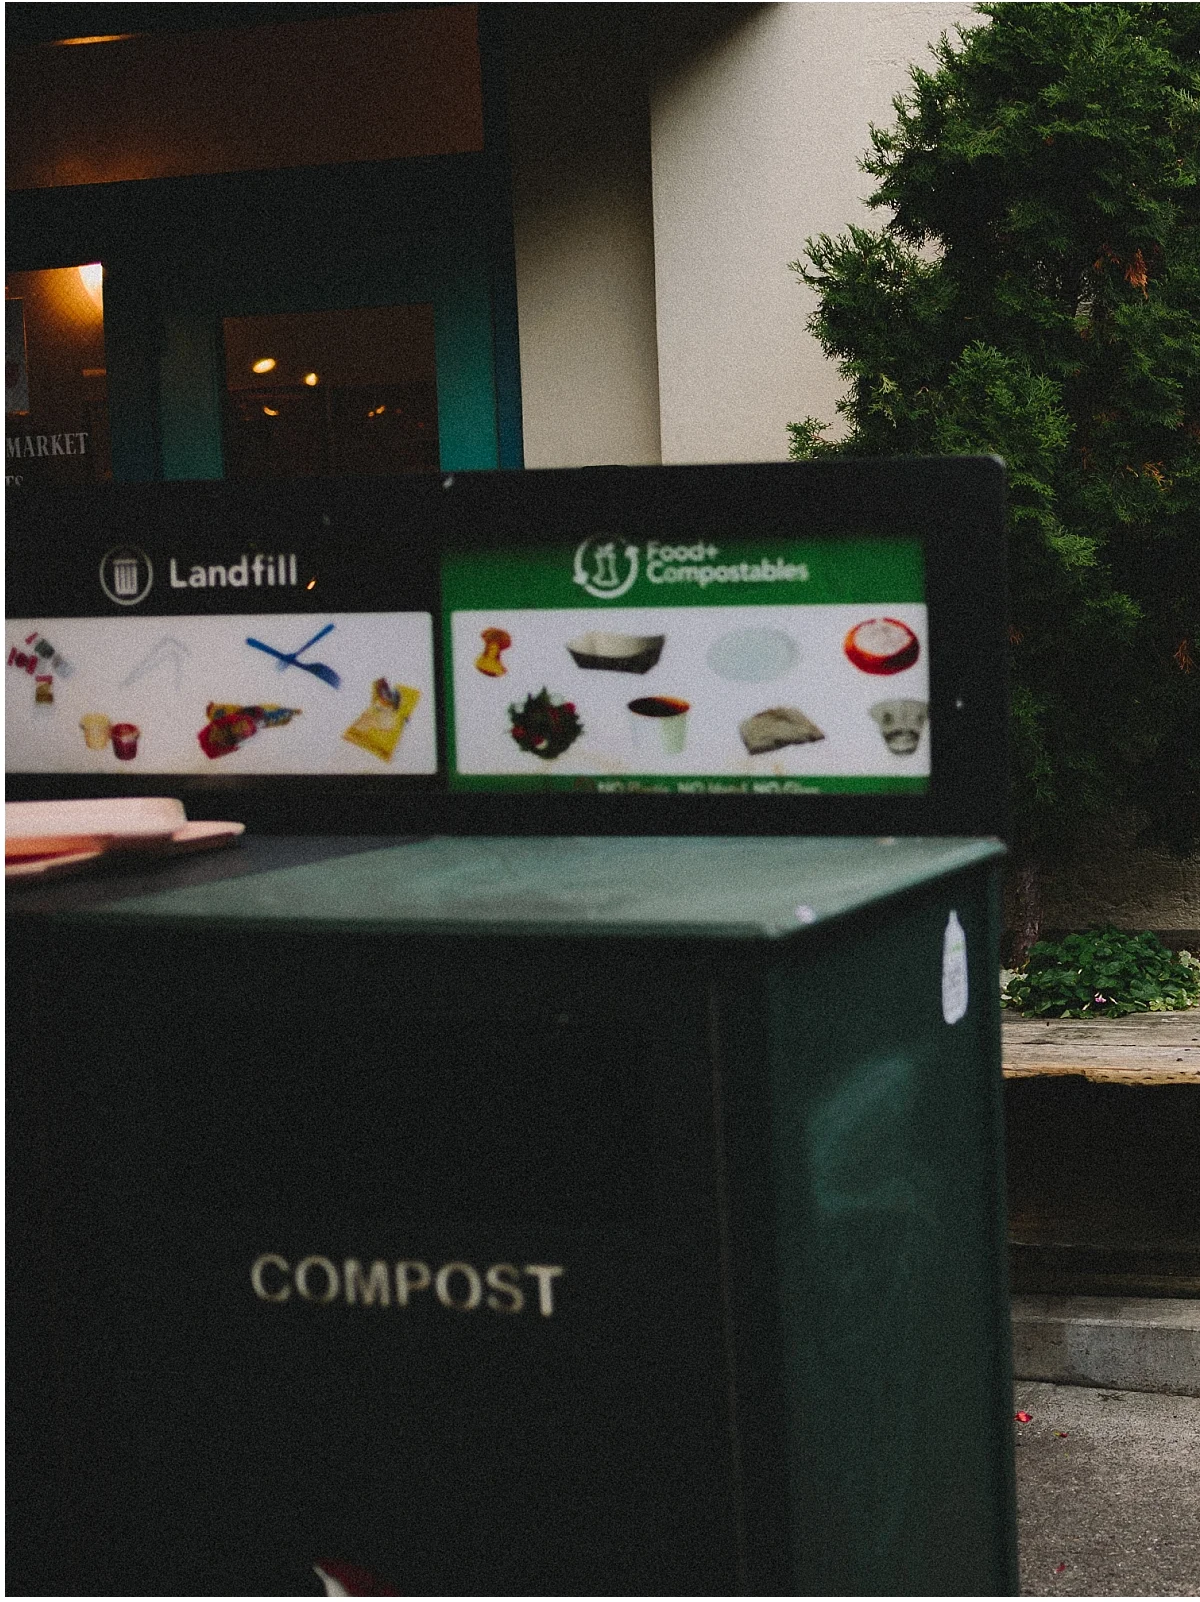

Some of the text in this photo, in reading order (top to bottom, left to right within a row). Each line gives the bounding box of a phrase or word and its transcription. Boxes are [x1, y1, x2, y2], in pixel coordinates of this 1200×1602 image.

[6, 432, 88, 458] MARKET
[648, 540, 719, 562] Food+
[170, 554, 297, 588] Landfill
[647, 557, 809, 588] Compostables
[251, 1253, 565, 1318] COMPOST
